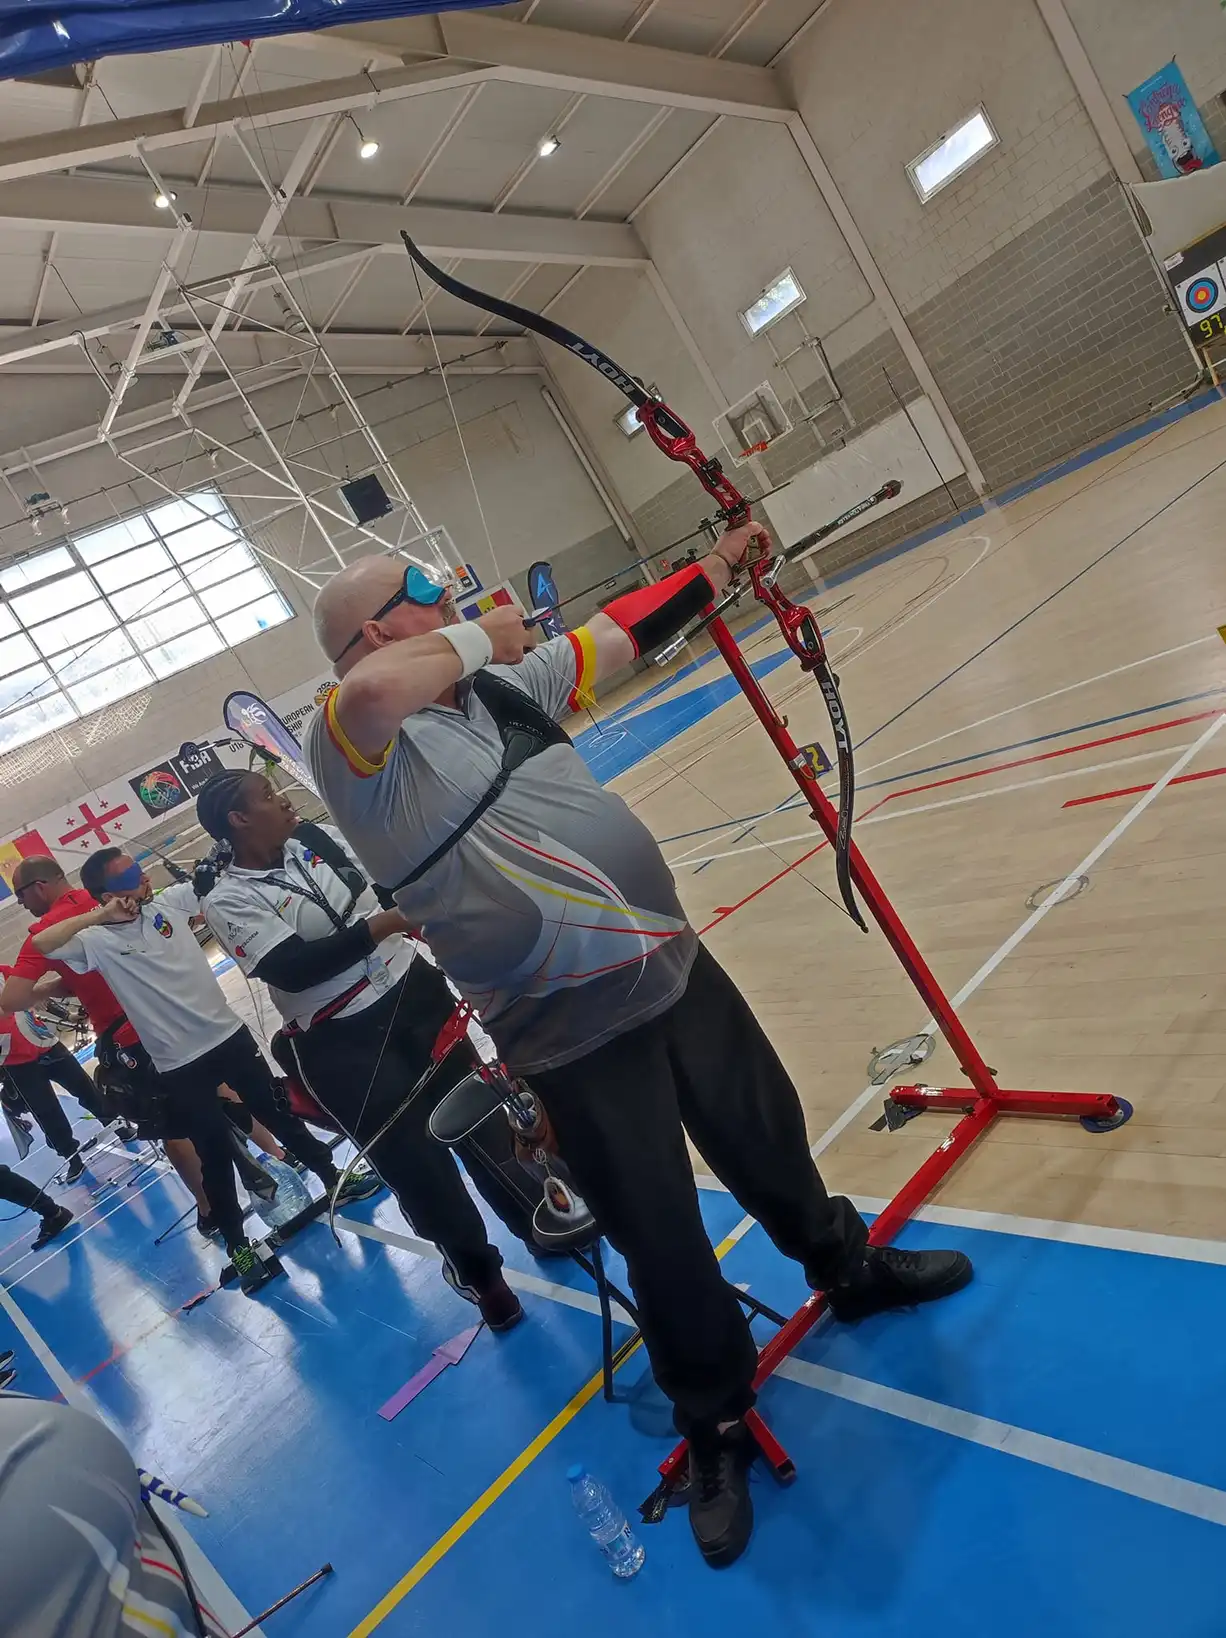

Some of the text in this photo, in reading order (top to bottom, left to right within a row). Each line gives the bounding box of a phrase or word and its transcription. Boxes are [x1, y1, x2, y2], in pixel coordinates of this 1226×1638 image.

[566, 343, 635, 394] HOYT
[282, 703, 315, 725] UROPEAN
[821, 681, 849, 753] HOYT
